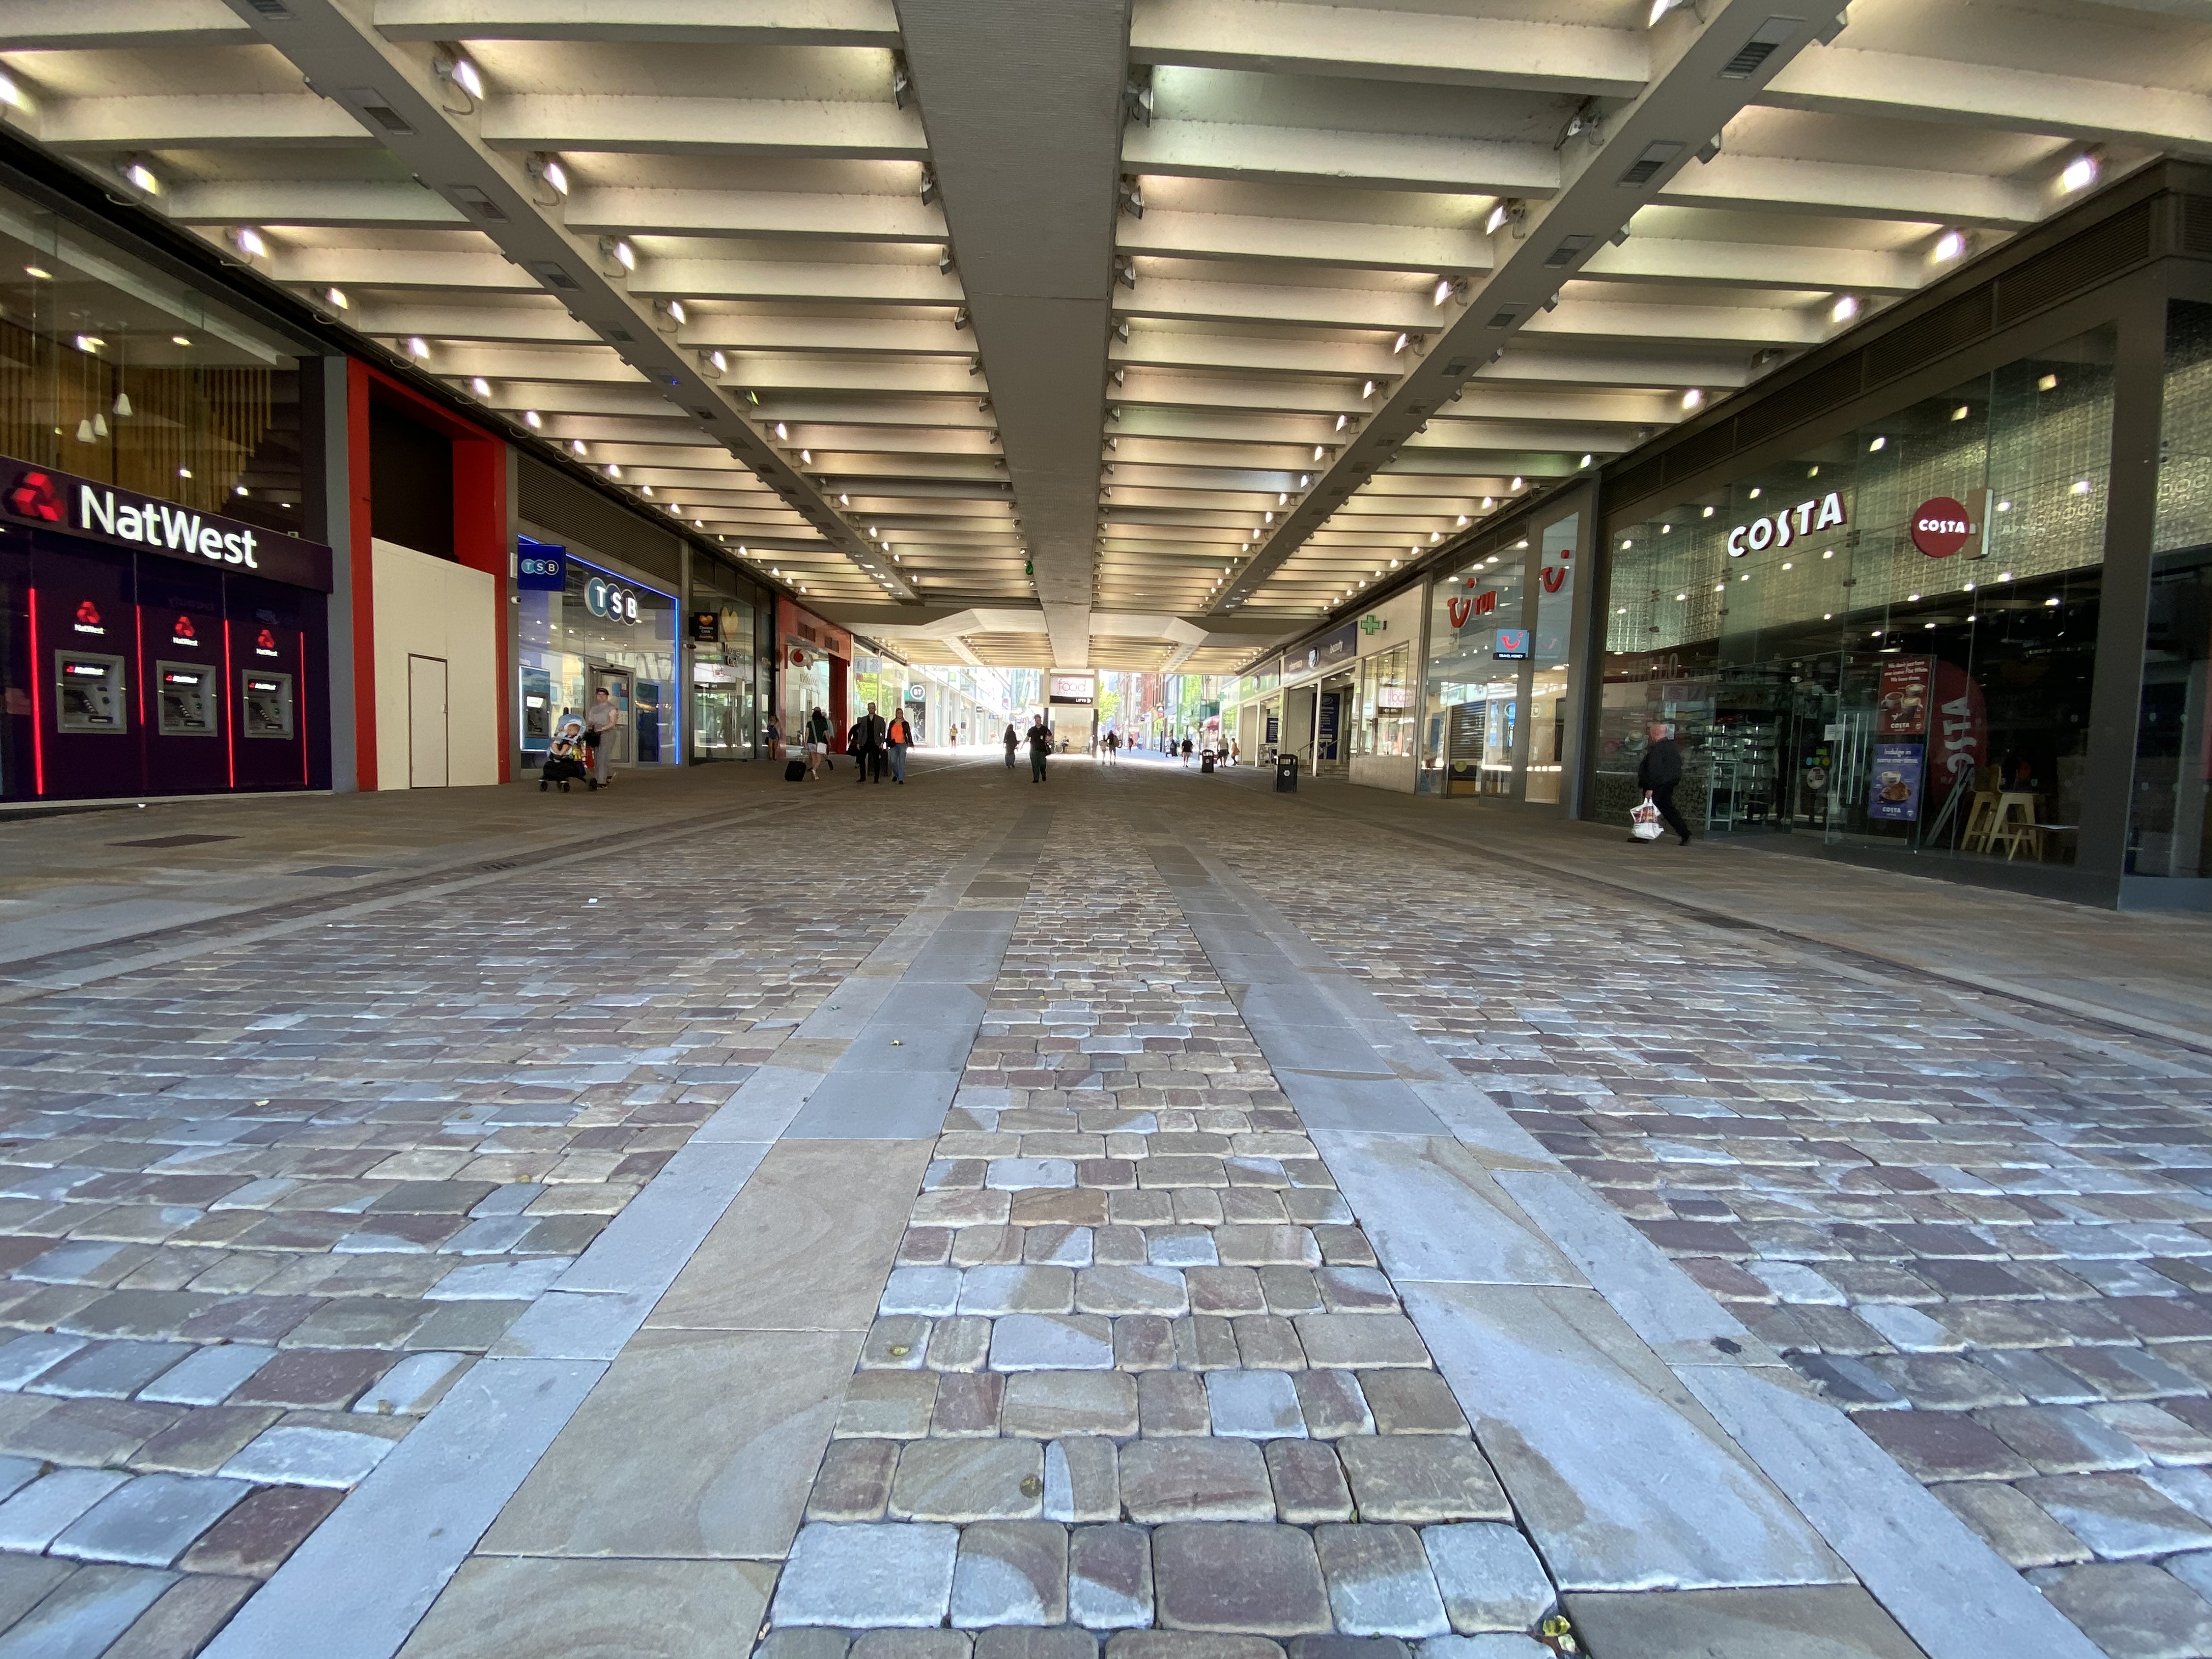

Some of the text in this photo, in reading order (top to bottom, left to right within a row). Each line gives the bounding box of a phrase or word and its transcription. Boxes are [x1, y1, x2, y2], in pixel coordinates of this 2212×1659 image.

[81, 484, 258, 568] NatWest
[1728, 492, 1847, 557] COSTA
[1918, 519, 1965, 534] COSTA
[524, 562, 556, 573] TSB
[595, 585, 637, 618] TSB
[74, 624, 104, 634] NatWest
[173, 637, 198, 646] NatWest
[256, 648, 278, 657] NatWest
[1057, 678, 1086, 692] food
